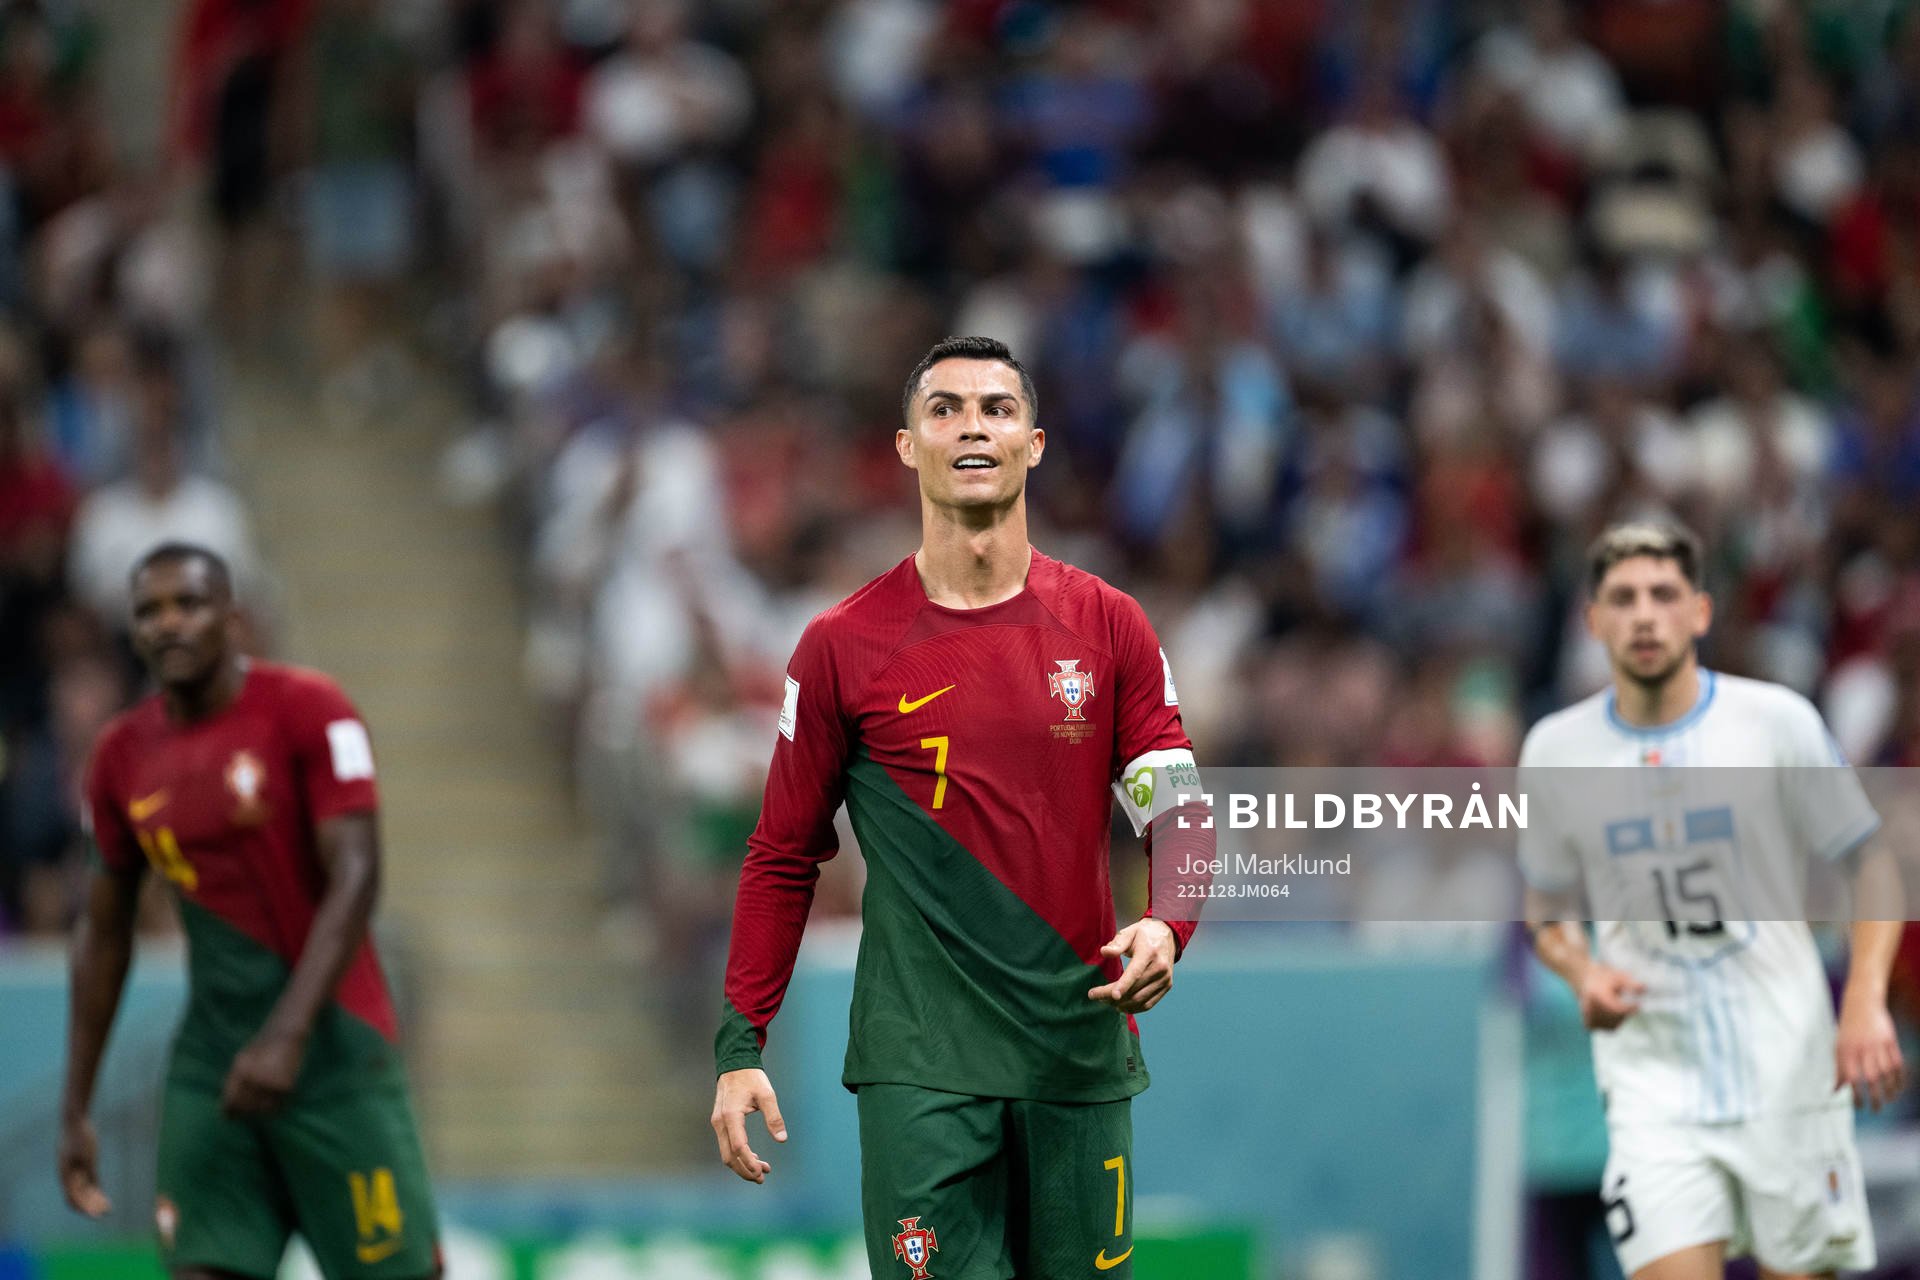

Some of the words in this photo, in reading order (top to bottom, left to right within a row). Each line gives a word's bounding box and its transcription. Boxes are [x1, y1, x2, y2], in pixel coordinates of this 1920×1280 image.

[921, 736, 949, 809] 7
[1652, 858, 1725, 939] 15
[349, 1167, 404, 1238] 14
[1103, 1155, 1125, 1237] 7
